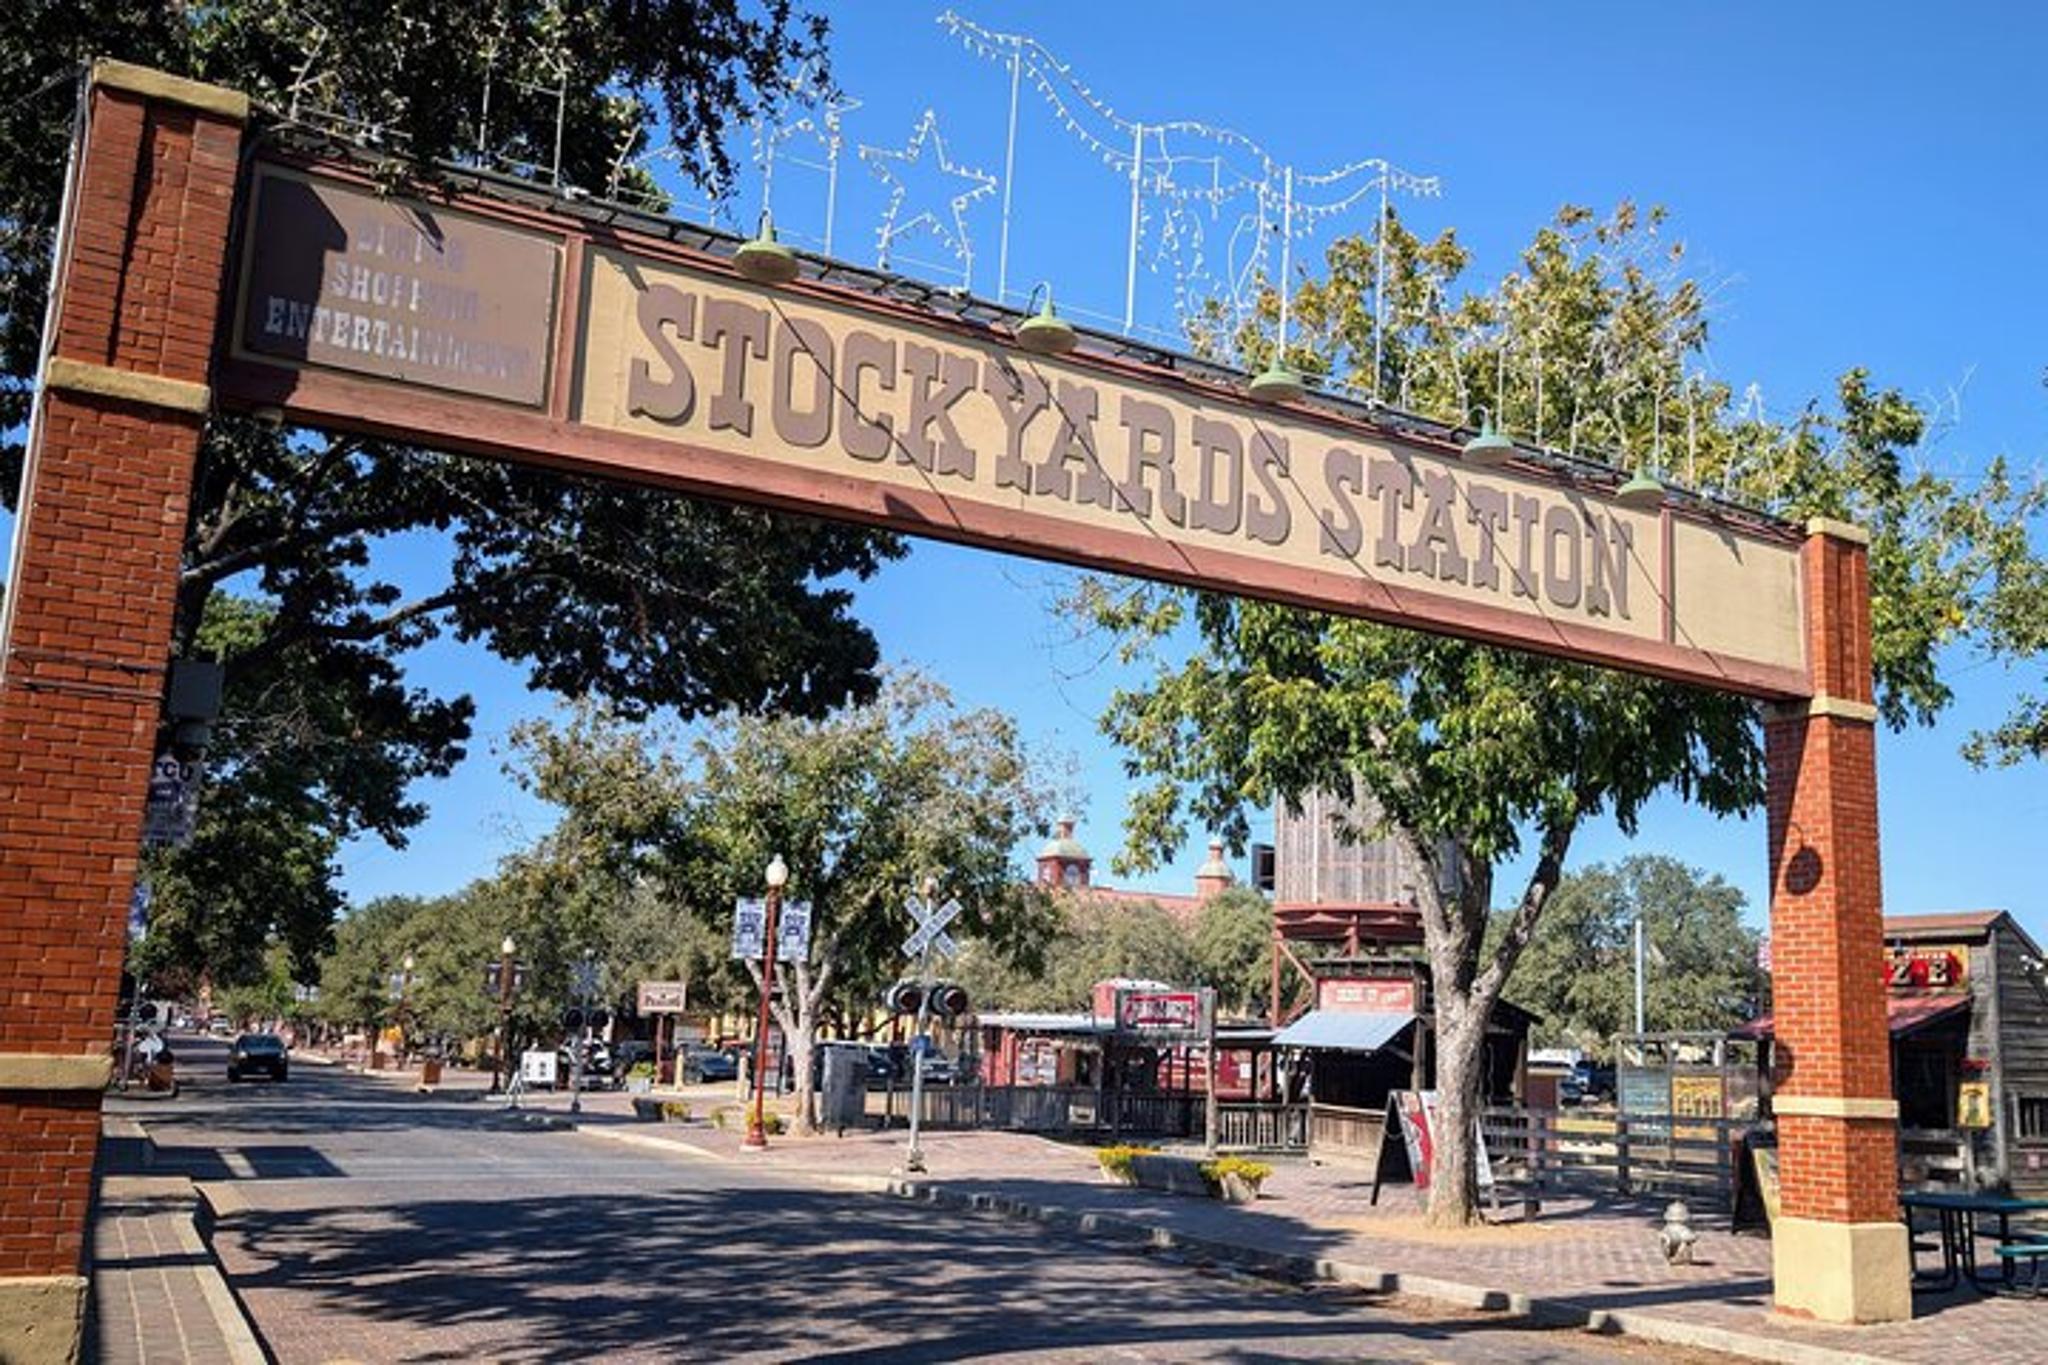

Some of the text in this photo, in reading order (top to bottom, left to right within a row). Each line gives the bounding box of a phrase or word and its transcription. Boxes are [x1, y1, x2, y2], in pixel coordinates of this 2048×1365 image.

[264, 296, 531, 380] ENTERTAI
[627, 283, 1632, 621] STOCKYARDS STATION
